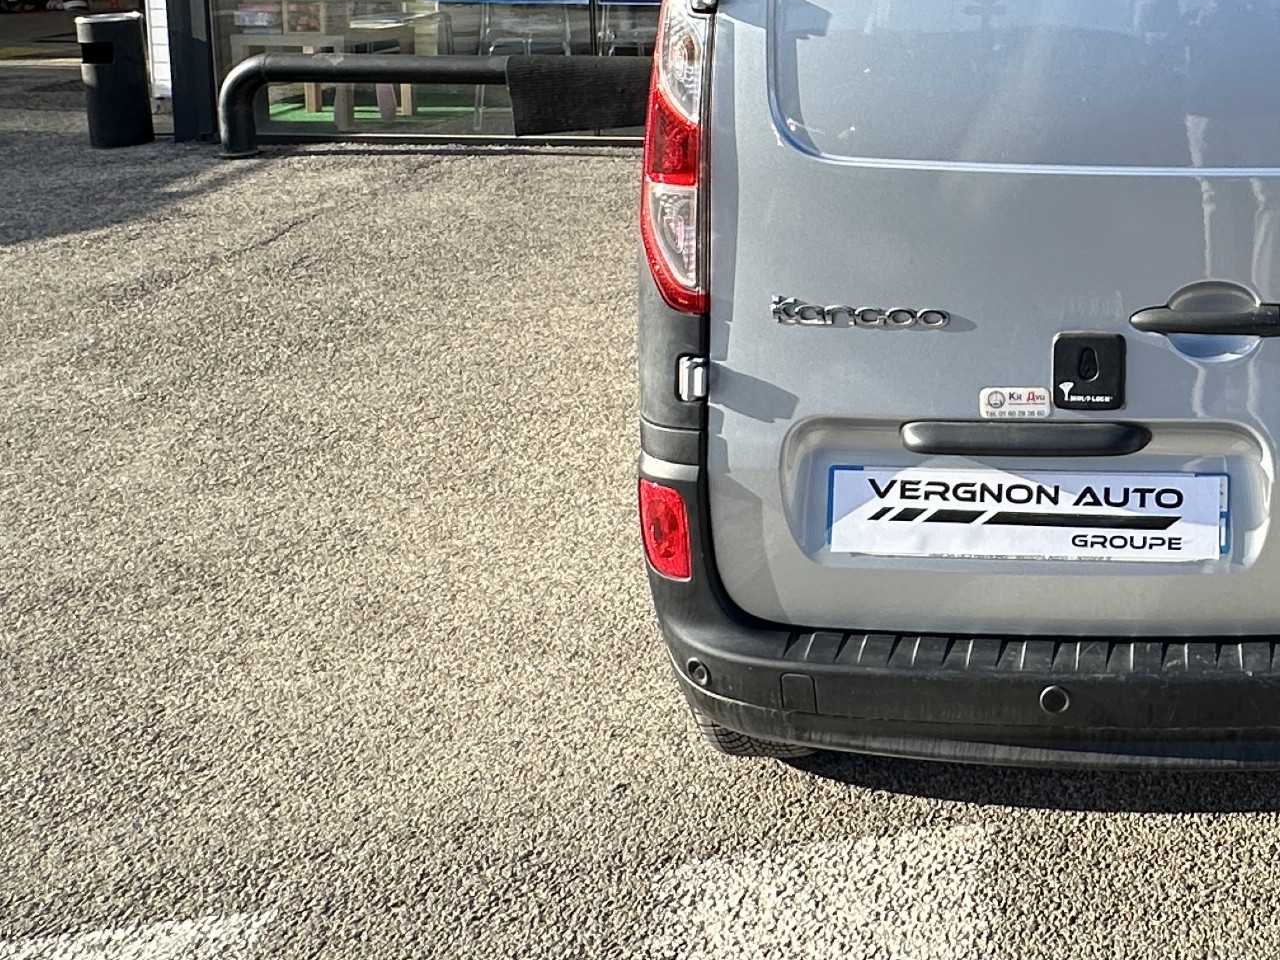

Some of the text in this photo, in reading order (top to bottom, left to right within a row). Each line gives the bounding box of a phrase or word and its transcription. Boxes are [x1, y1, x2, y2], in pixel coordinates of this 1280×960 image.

[770, 293, 950, 331] Kangoo
[867, 478, 1184, 509] VERGNON AUTO
[1071, 534, 1183, 551] GROUPE
